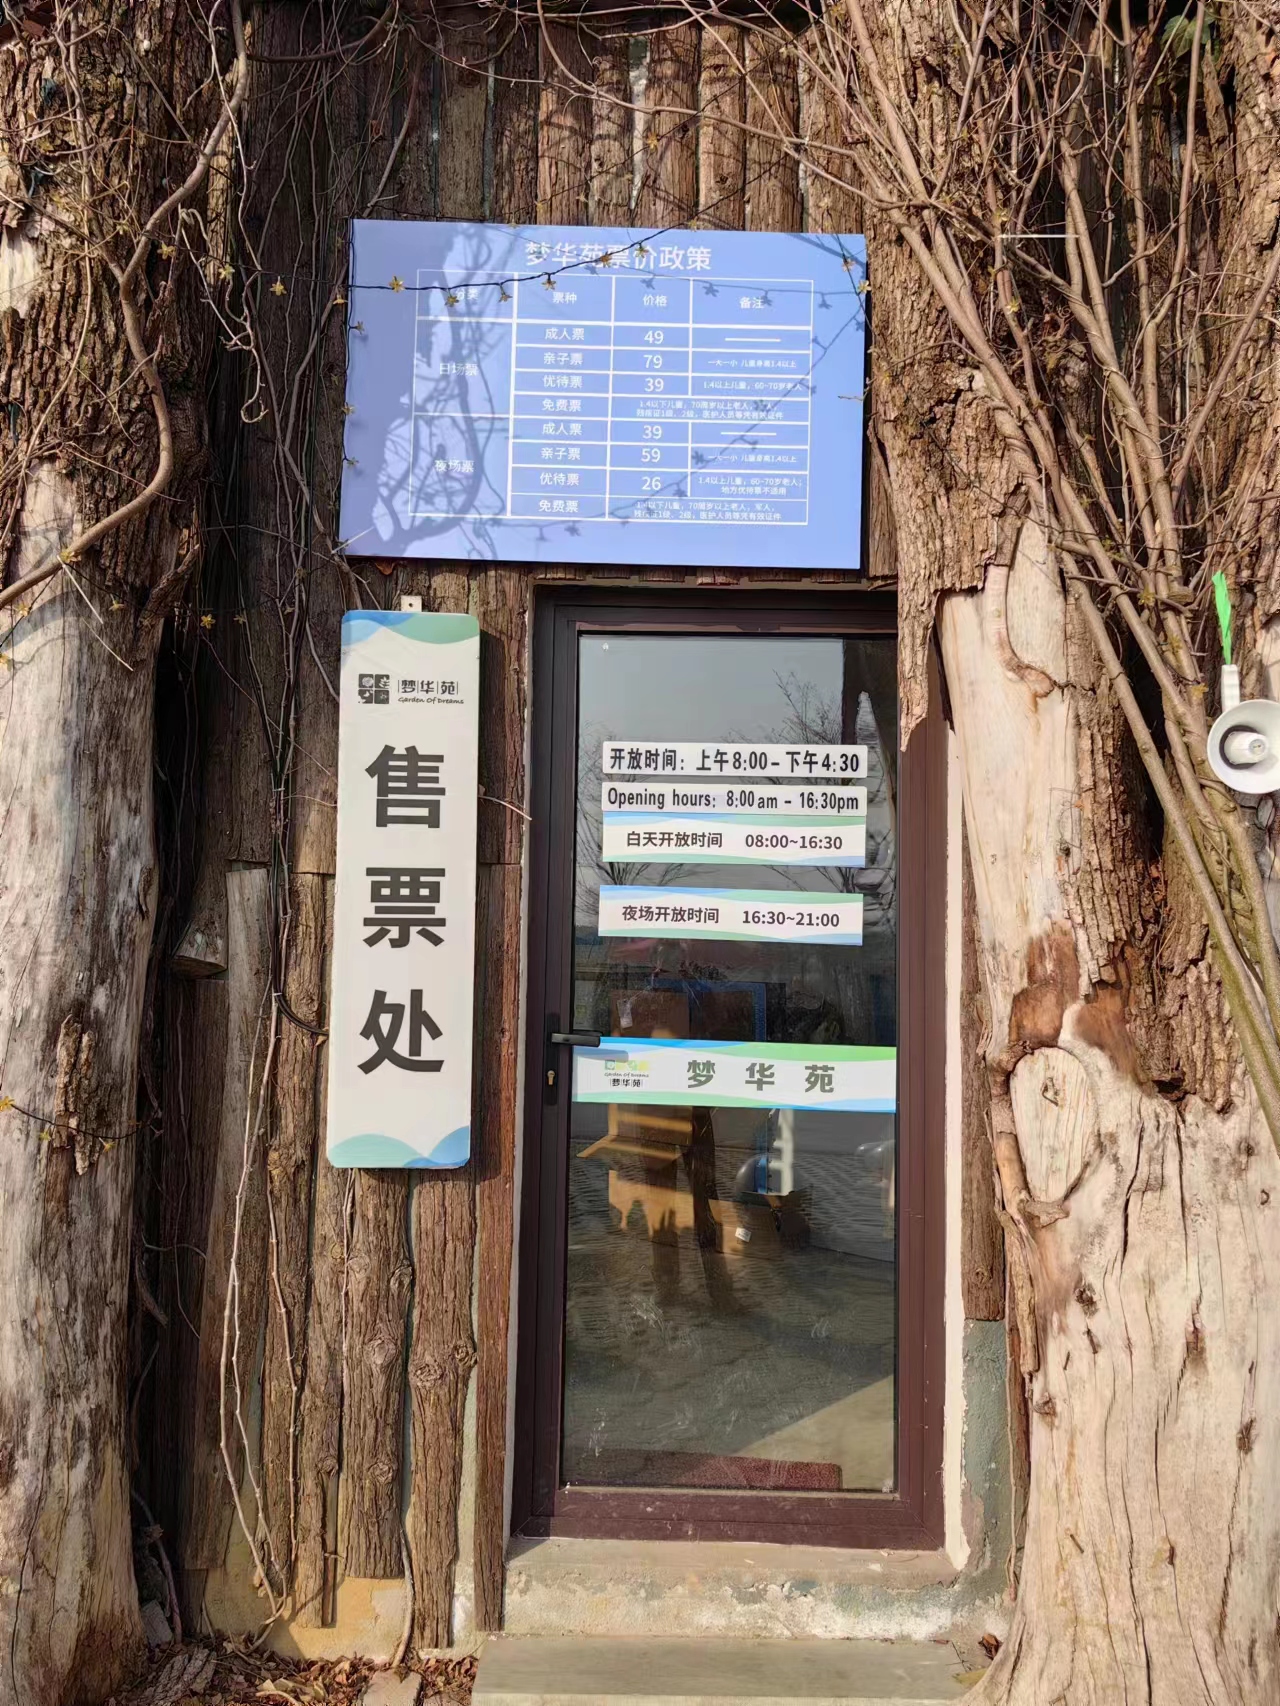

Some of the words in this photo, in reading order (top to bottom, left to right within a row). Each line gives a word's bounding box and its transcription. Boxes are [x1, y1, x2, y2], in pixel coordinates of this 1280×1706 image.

[525, 241, 711, 272] 梦华苑票价政策
[552, 291, 577, 304] 票种
[643, 294, 668, 307] 价格
[739, 296, 764, 309] 备注
[545, 327, 585, 341] 成人票
[644, 330, 664, 345] 49
[543, 352, 583, 366] 亲子票
[643, 354, 663, 369] 79
[440, 363, 479, 377] 日场票
[542, 375, 583, 389] 优待票
[644, 377, 664, 392] 39
[542, 398, 582, 412] 免费票
[542, 422, 582, 436] 成人票
[642, 425, 662, 440] 39
[540, 447, 581, 461] 亲子票
[641, 448, 661, 463] 59
[434, 459, 475, 473] 夜场票
[539, 472, 580, 486] 优待票
[641, 476, 662, 491] 26
[538, 499, 579, 513] 免费票
[400, 679, 456, 694] 梦华苑
[426, 697, 437, 705] Of
[437, 697, 464, 705] Dreams
[607, 787, 665, 809] Opening
[672, 789, 717, 808] hours:
[799, 791, 859, 814] 16:30pm
[626, 830, 723, 849] 白天开放时间
[745, 833, 843, 850] 08:00~16:30
[356, 744, 446, 1075] 售票处
[622, 905, 720, 924] 夜场开放时间
[742, 909, 840, 927] 16:30~21:00
[612, 1078, 641, 1087] 梦华苑
[687, 1059, 836, 1093] 梦华苑
